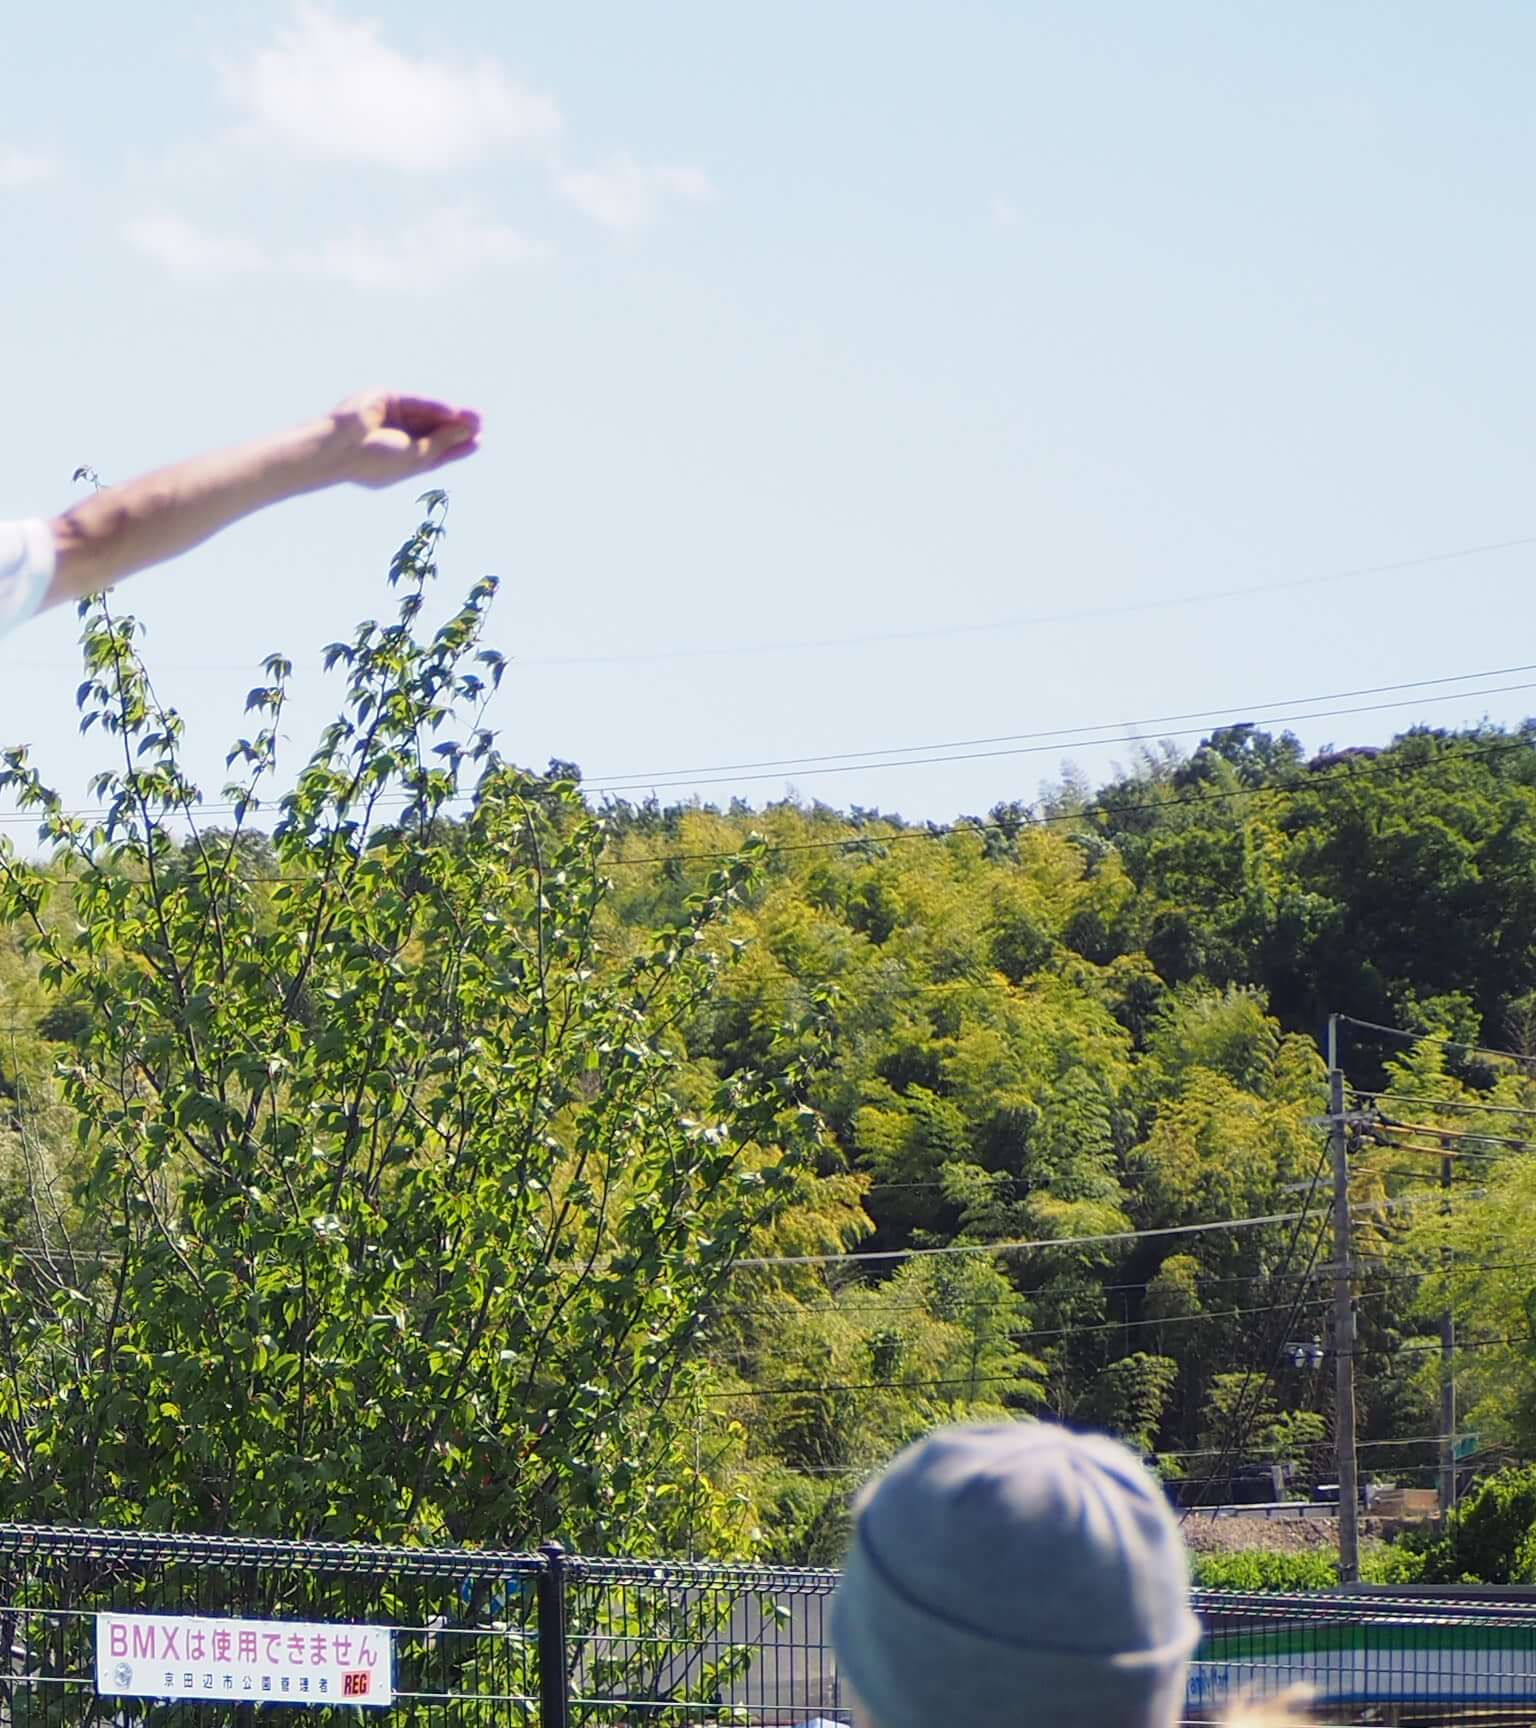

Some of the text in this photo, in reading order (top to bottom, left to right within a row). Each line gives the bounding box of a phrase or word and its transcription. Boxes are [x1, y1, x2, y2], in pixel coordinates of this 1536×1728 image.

[109, 1623, 378, 1667] BMXは使用できません
[343, 1673, 368, 1695] REG
